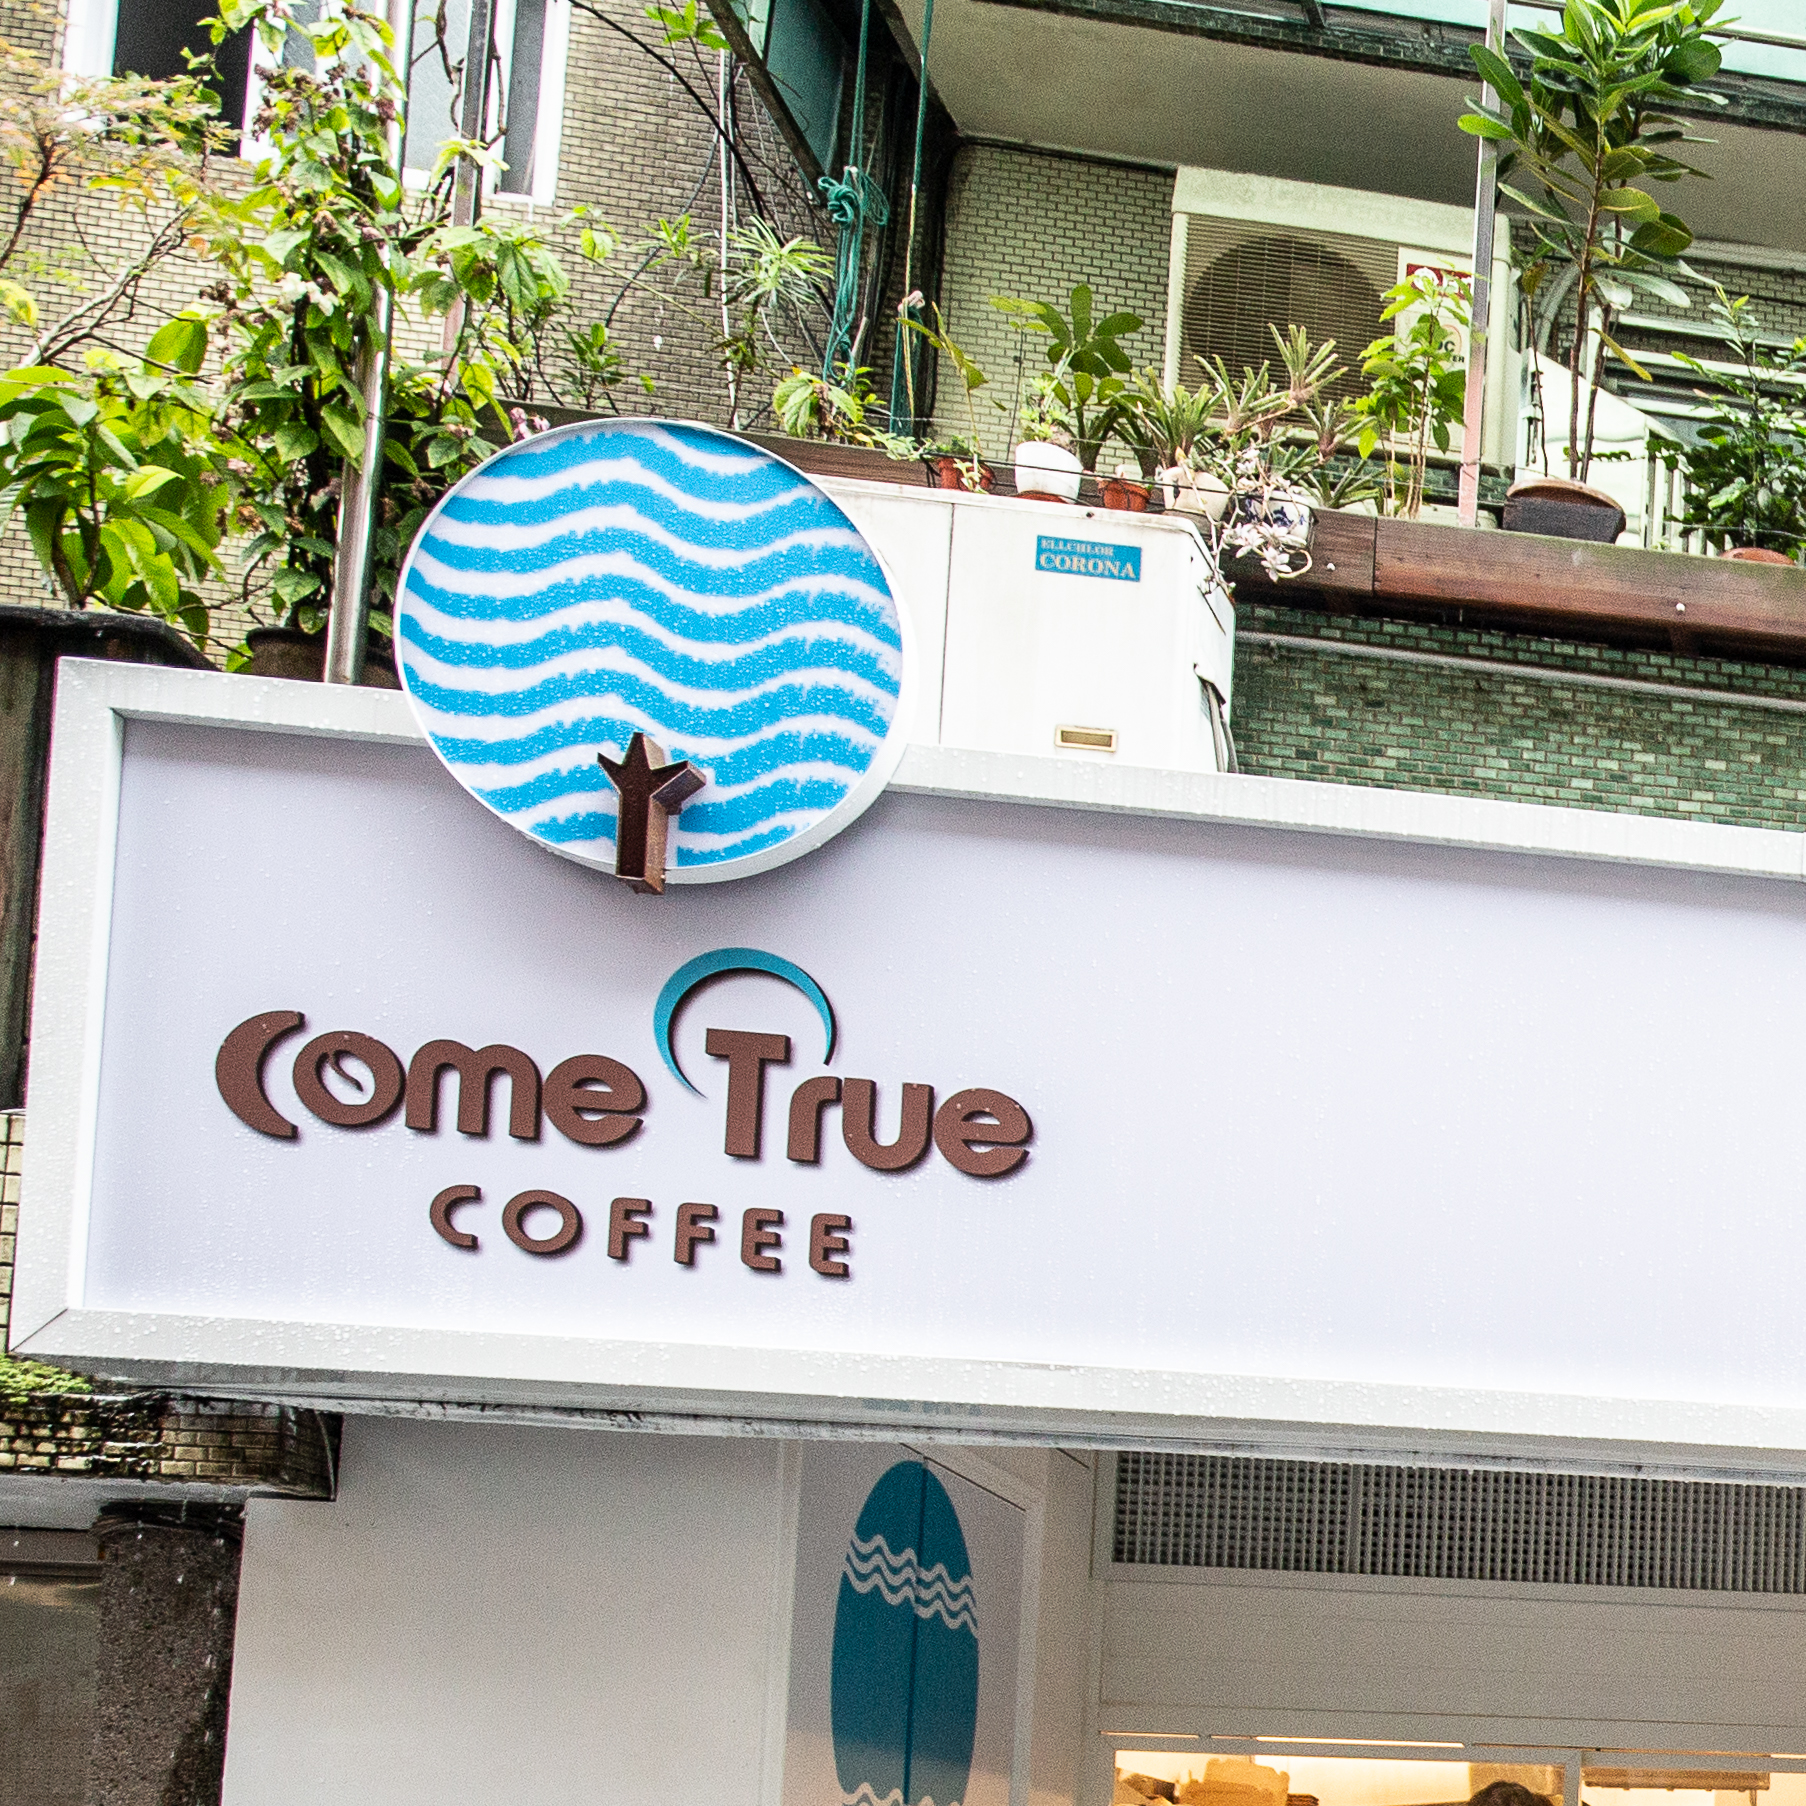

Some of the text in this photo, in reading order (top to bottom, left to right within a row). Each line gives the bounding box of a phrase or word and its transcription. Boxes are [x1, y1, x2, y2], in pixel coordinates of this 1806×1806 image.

[1040, 552, 1136, 579] CORONA
[215, 1010, 1035, 1181] Come True
[429, 1184, 853, 1281] COFFEE
